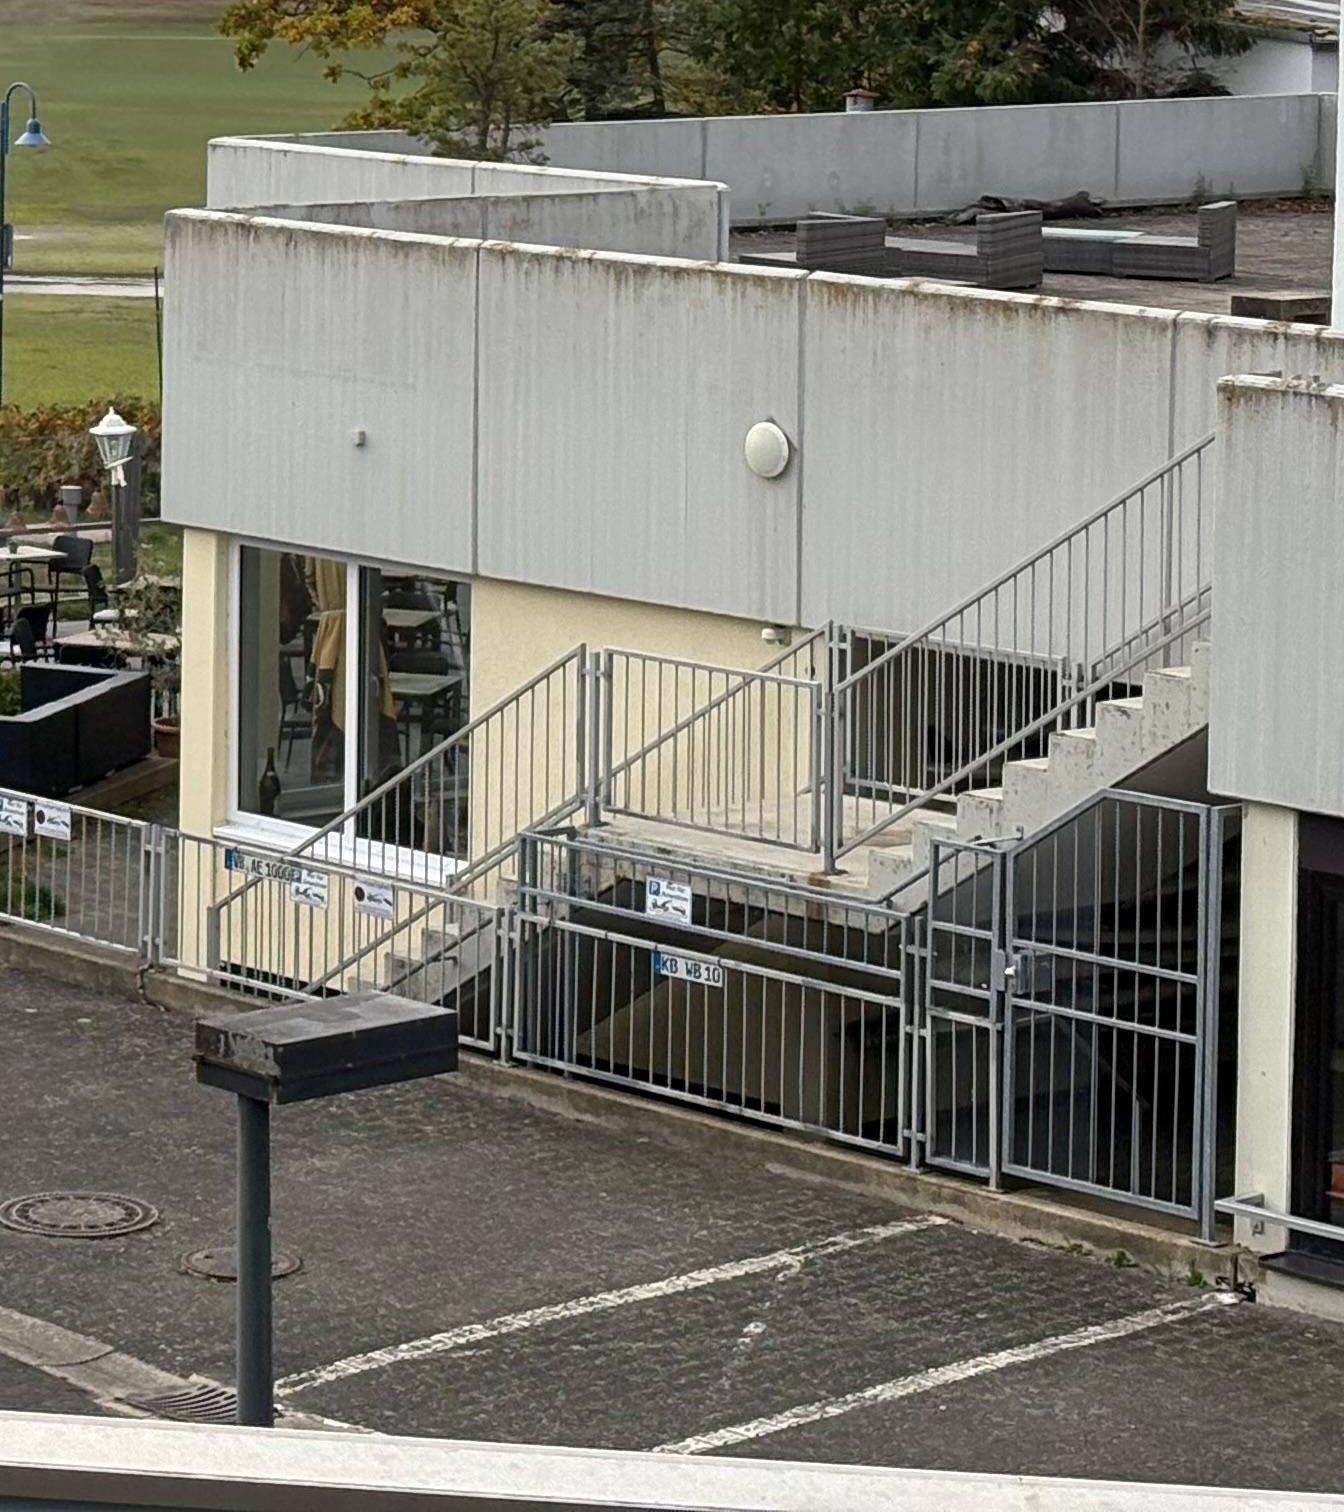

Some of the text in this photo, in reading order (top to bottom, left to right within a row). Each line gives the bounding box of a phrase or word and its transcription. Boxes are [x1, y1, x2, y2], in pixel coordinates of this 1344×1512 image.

[661, 956, 721, 984] KB WB 10
